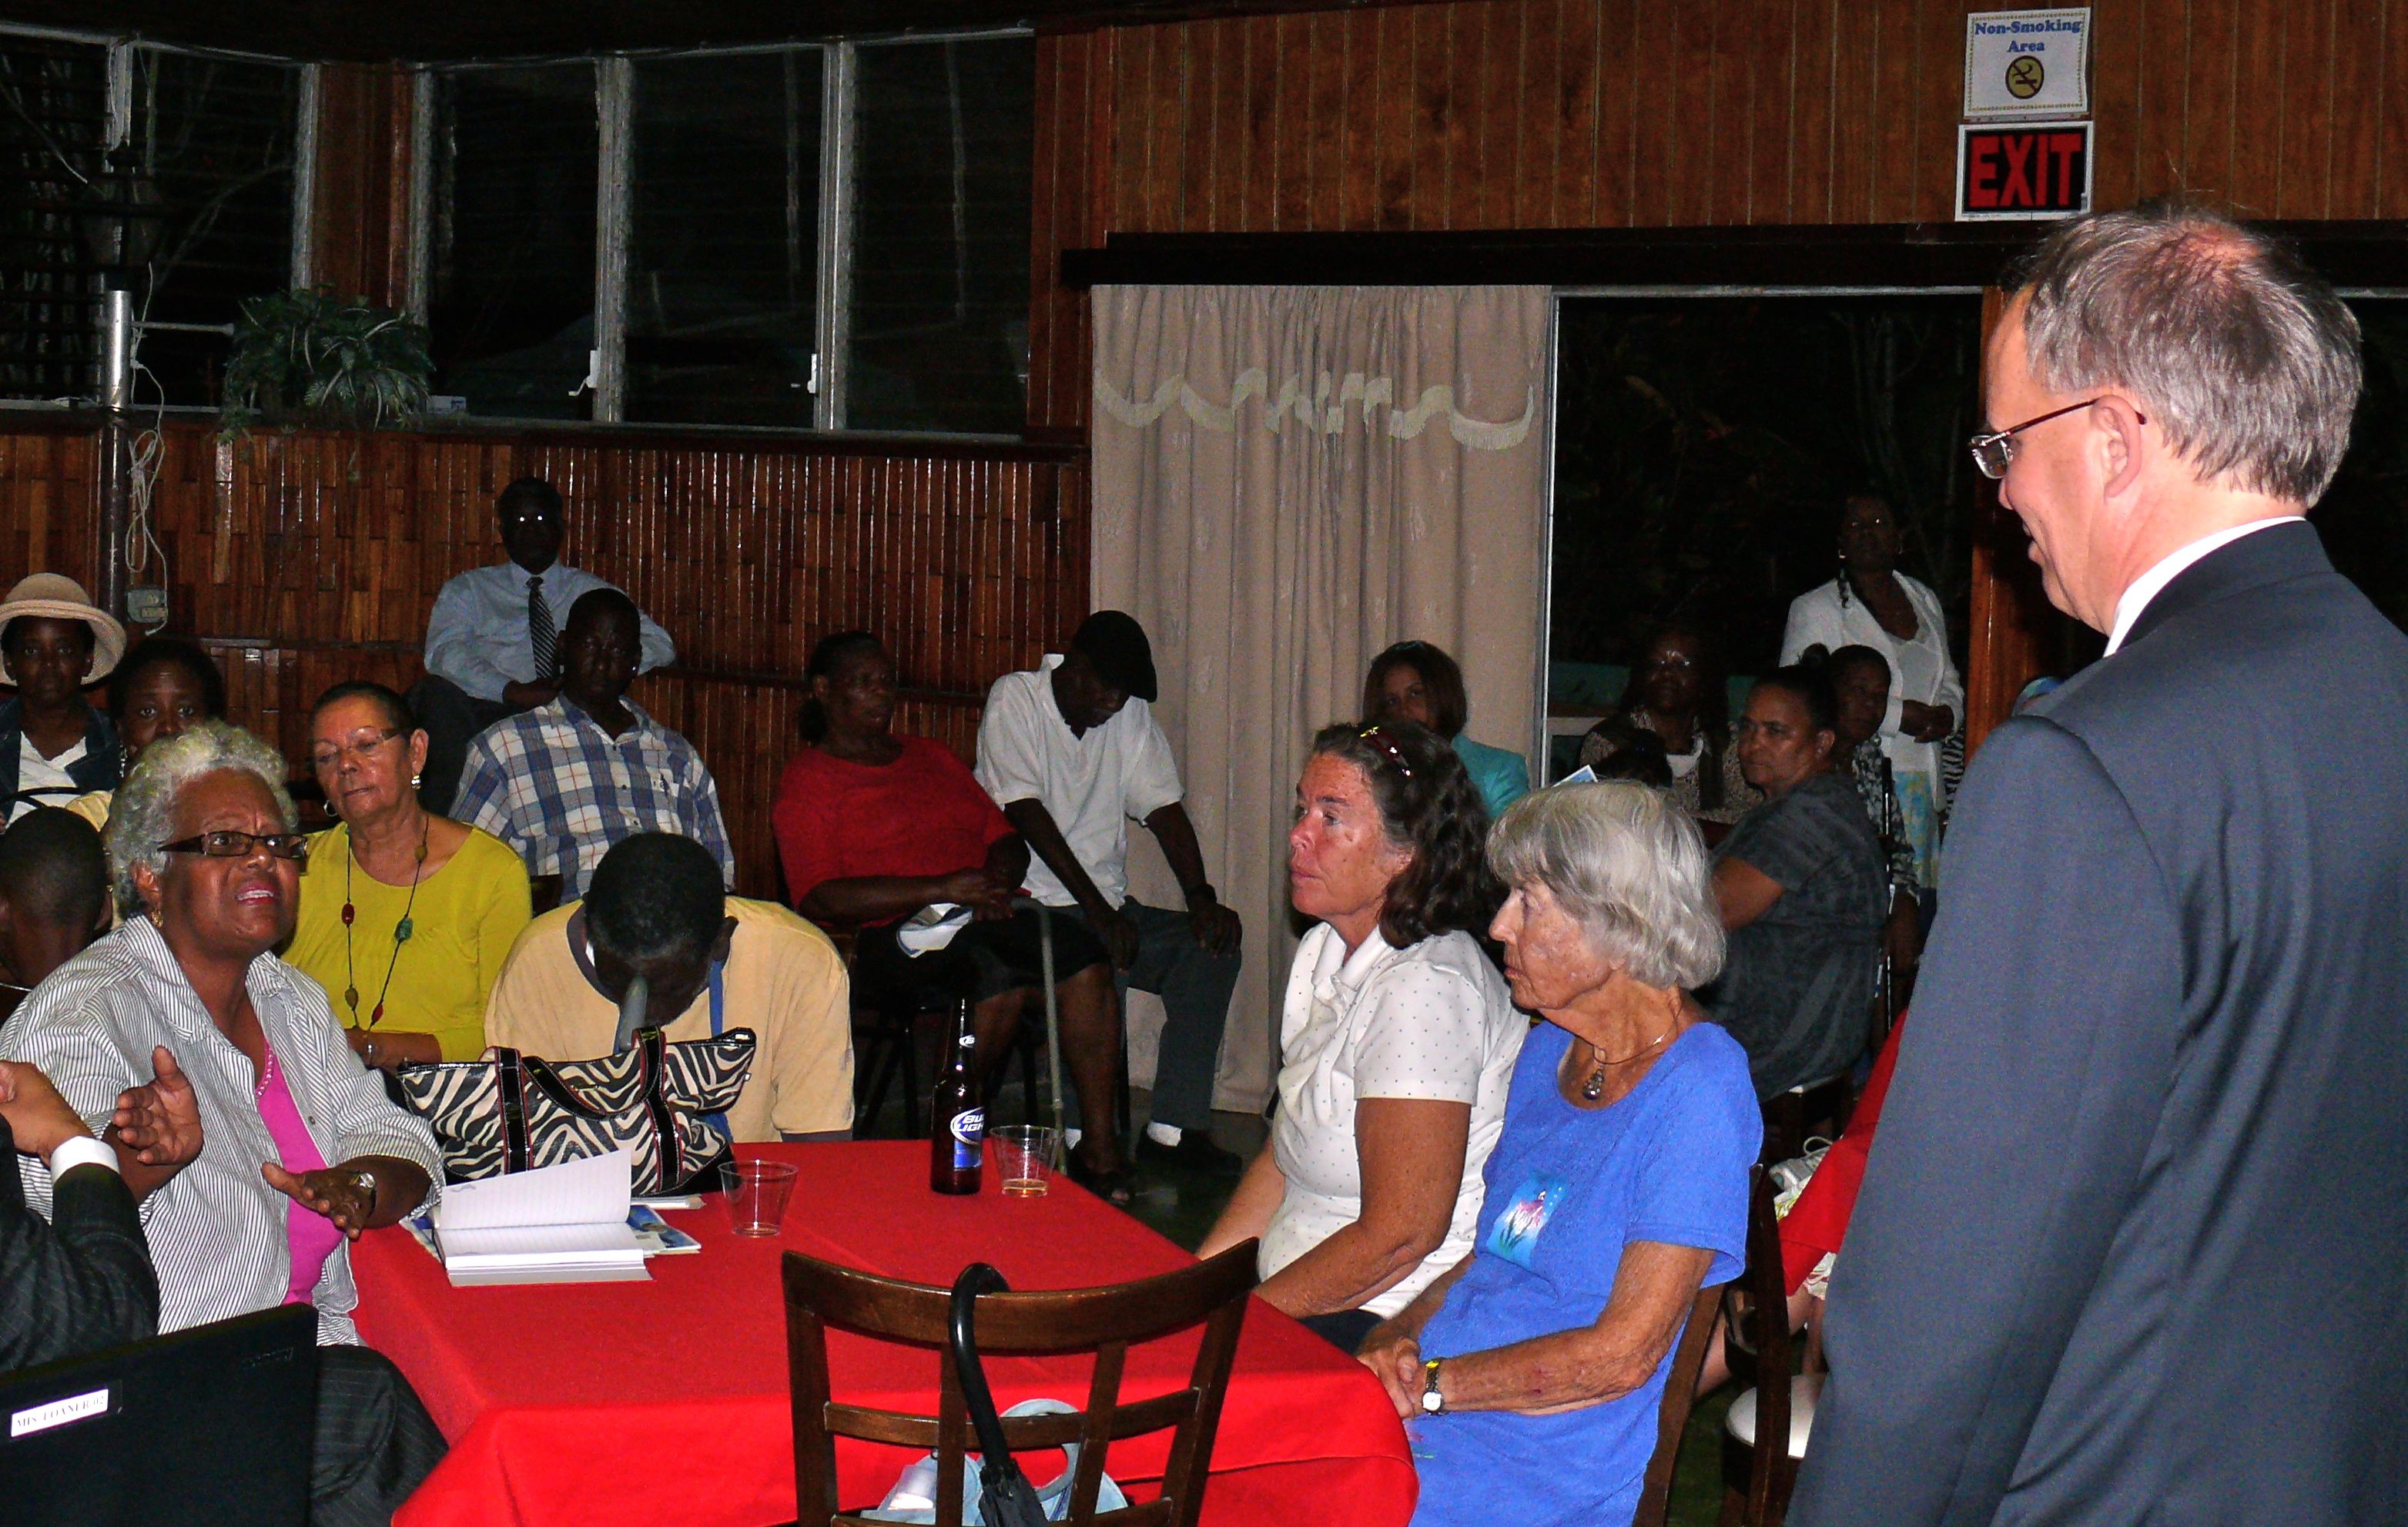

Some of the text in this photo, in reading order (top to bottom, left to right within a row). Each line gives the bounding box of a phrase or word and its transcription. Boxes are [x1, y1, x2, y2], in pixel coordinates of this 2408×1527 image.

[1974, 19, 2082, 35] Non-Smoking
[2007, 41, 2045, 53] Area
[1970, 134, 2081, 207] EXIT
[962, 1113, 984, 1123] BU
[954, 1122, 983, 1132] LIGH
